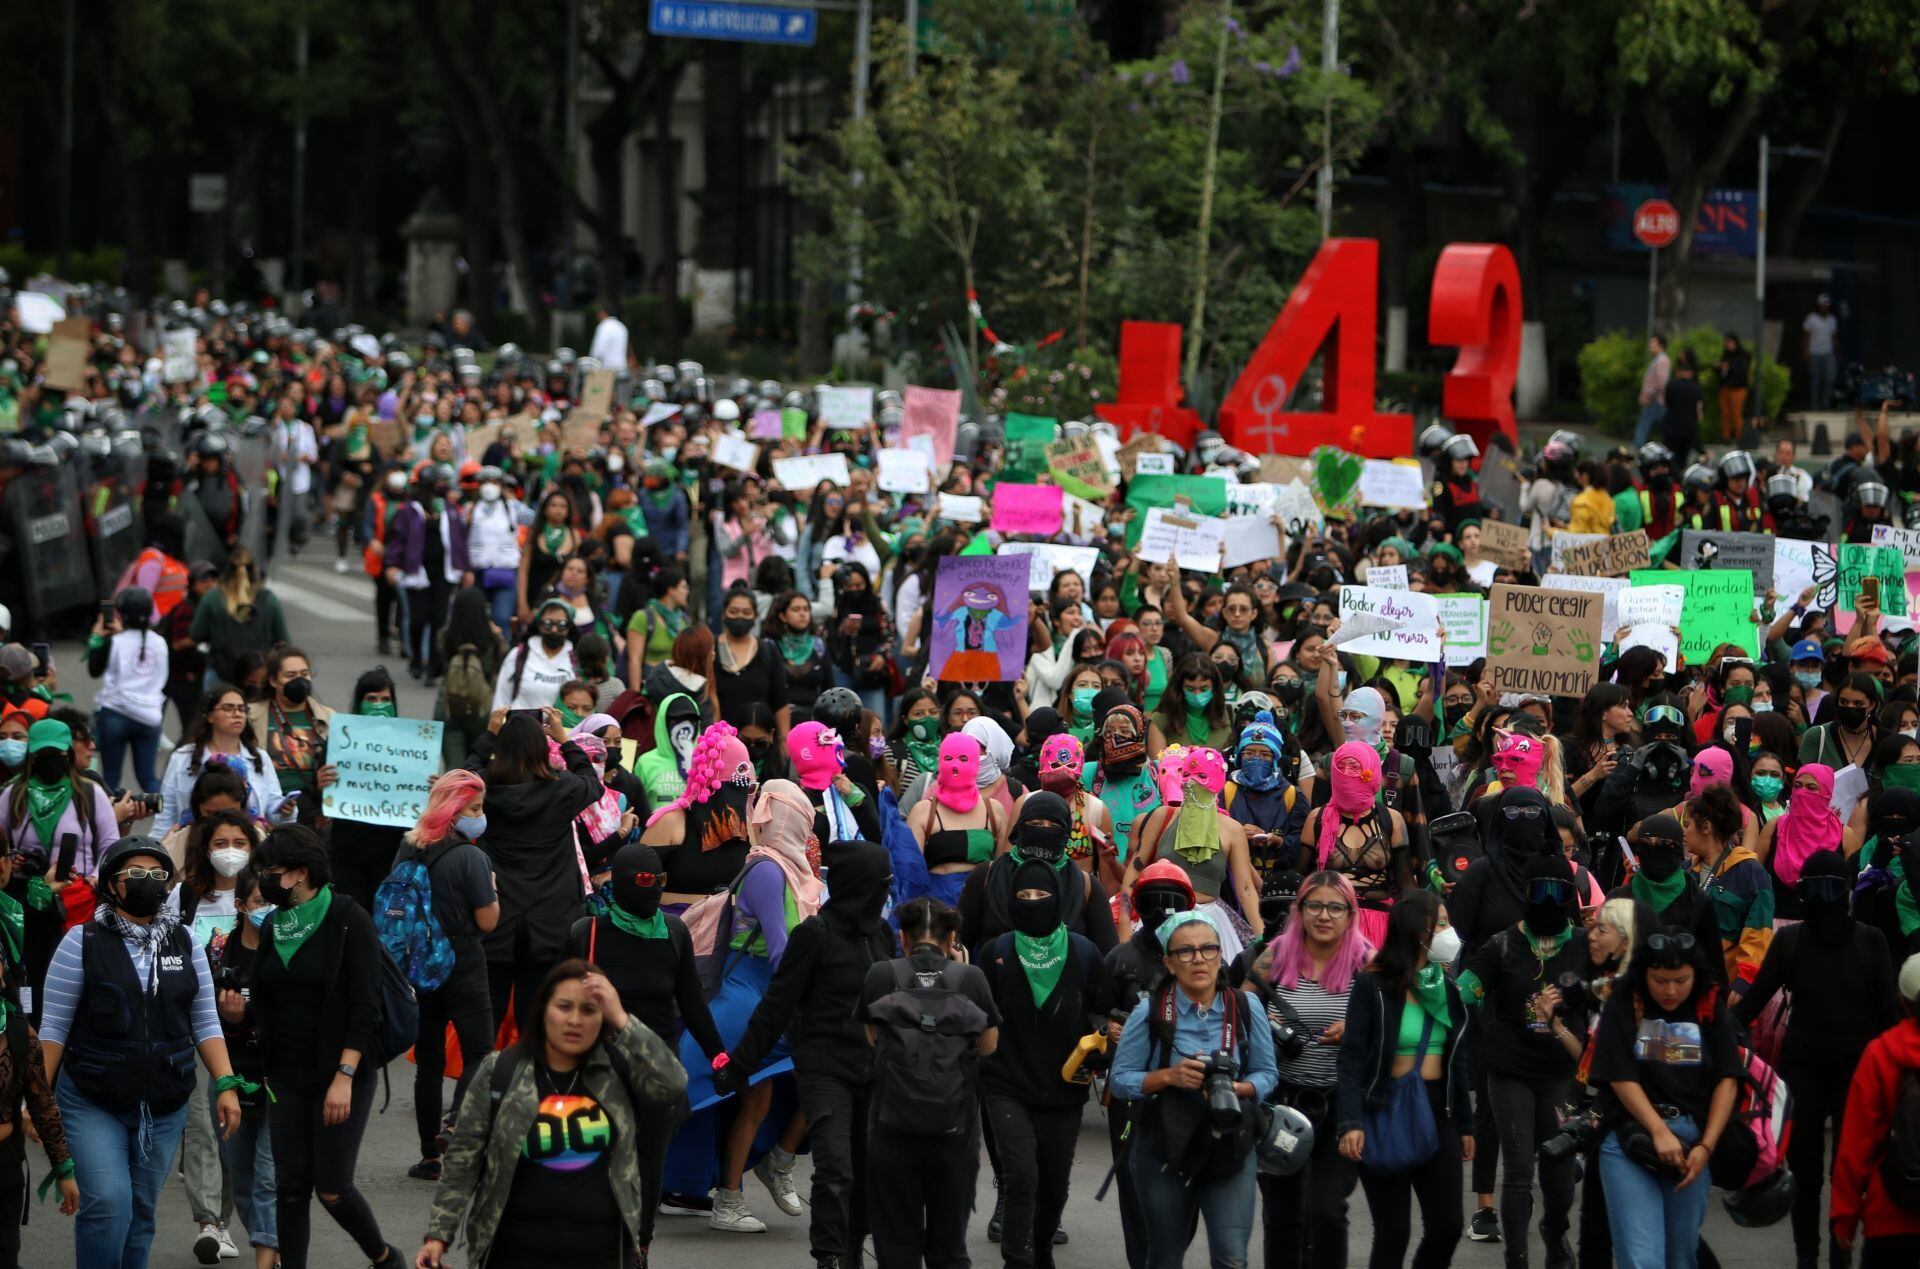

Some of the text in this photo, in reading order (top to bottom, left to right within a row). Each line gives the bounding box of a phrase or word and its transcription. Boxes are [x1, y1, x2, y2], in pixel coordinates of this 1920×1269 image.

[1638, 213, 1677, 234] ALTO
[1574, 546, 1590, 561] MI
[1594, 534, 1648, 559] CUERPO
[1720, 544, 1766, 553] MADRE POR
[1548, 579, 1563, 588] NO
[1342, 588, 1414, 620] Poder elegir
[1394, 632, 1429, 644] morir
[1530, 670, 1553, 692] NO
[366, 743, 382, 753] no
[336, 761, 398, 774] no restes
[346, 780, 391, 792] mucho
[339, 799, 421, 820] CHINGUES
[160, 954, 183, 966] MVS
[1165, 1004, 1173, 1021] EOS
[526, 1106, 608, 1159] DC
